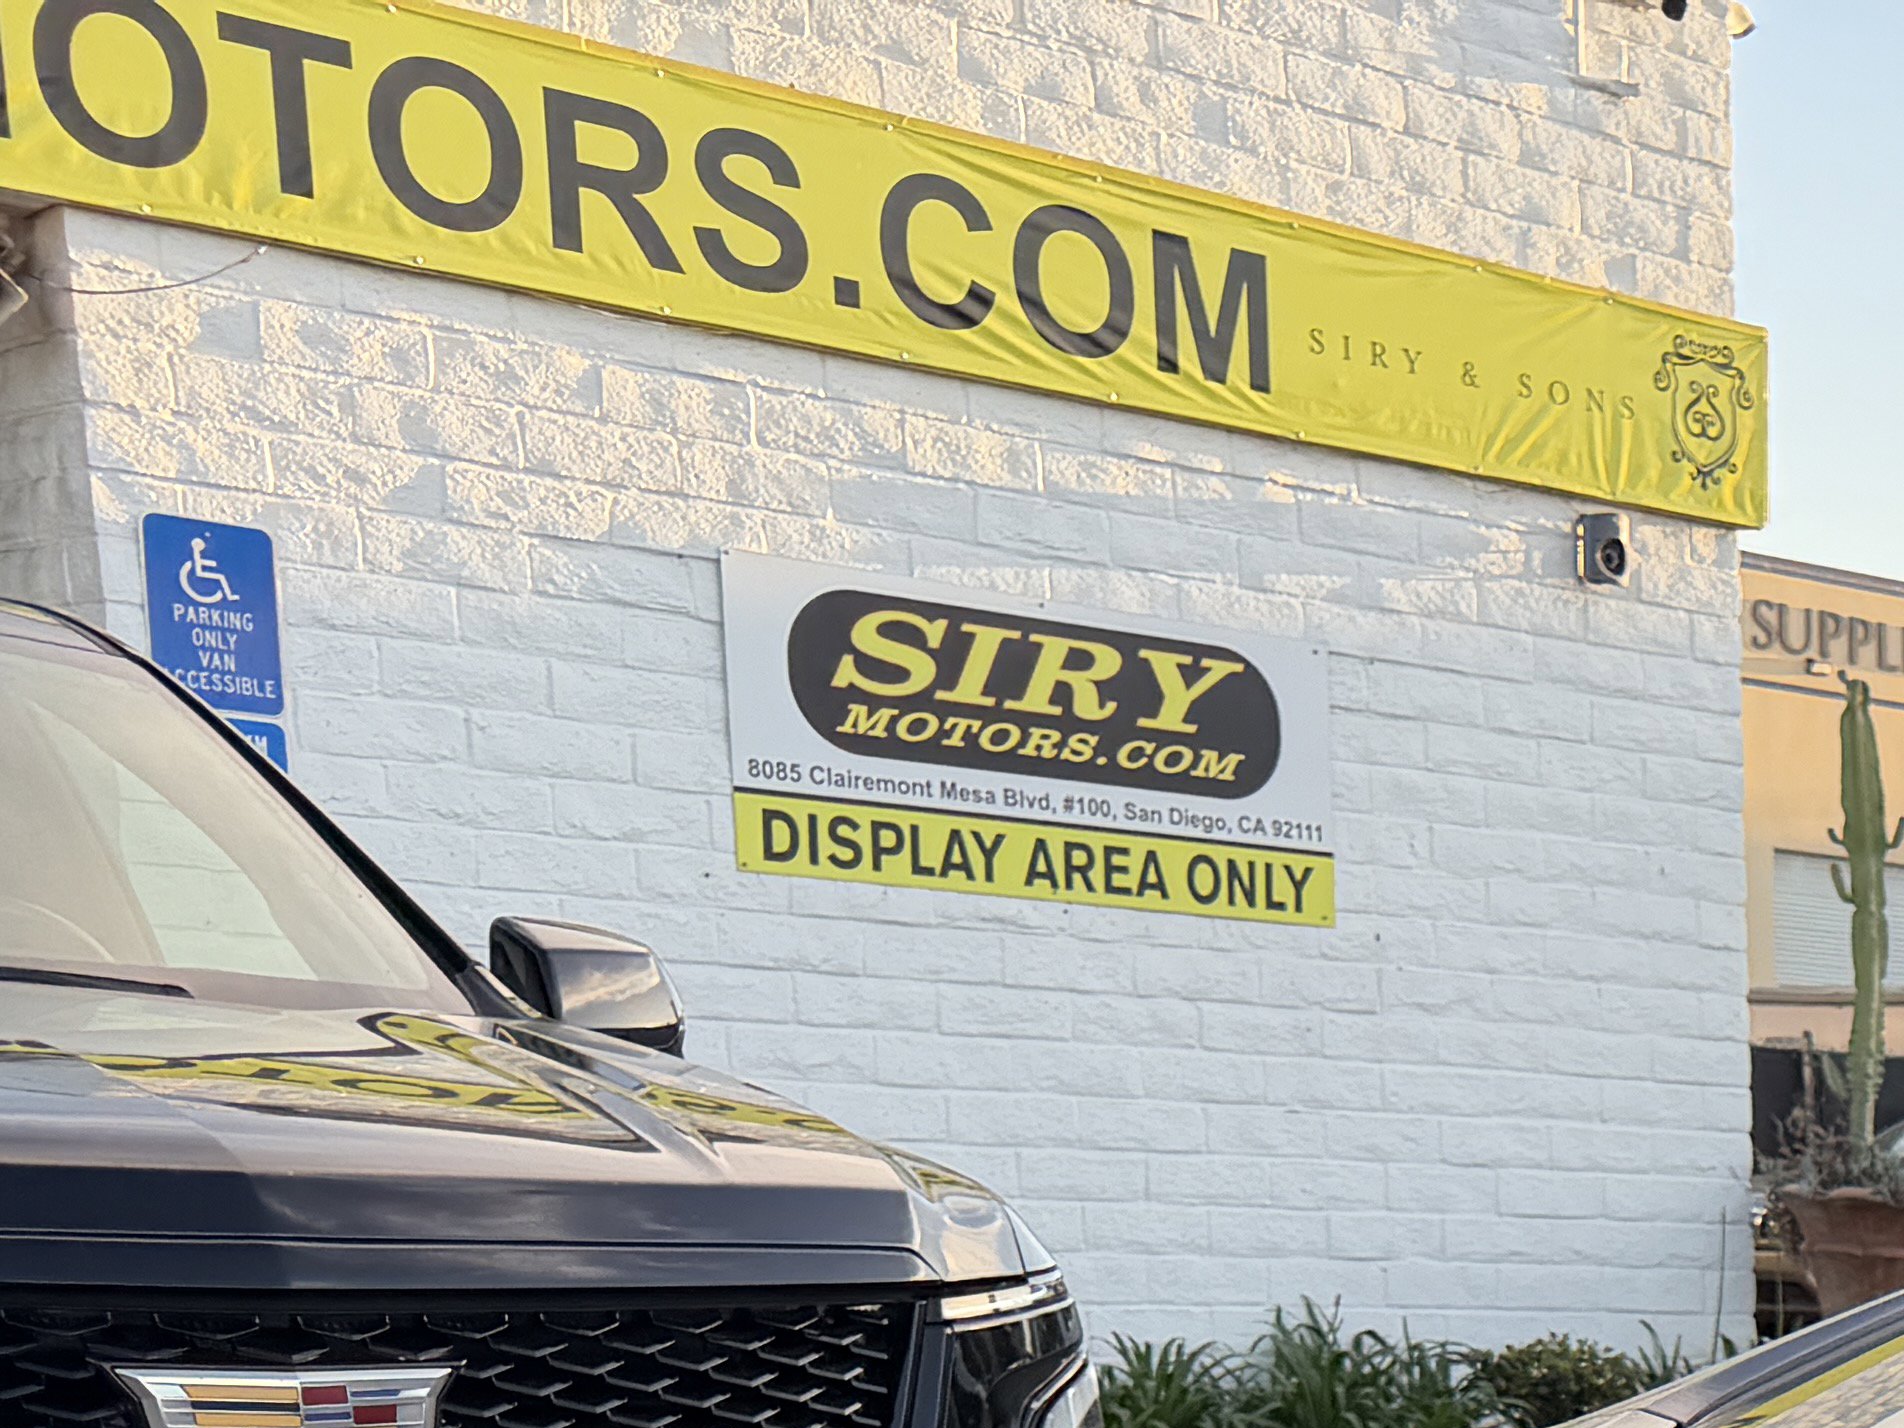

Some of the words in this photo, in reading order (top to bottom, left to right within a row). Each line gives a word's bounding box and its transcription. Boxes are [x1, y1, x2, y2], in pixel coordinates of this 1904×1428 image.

[0, 0, 1271, 395] OTORS.COM
[1308, 327, 1423, 375] SIRY
[1461, 360, 1482, 389] &
[1517, 372, 1635, 421] SONS
[173, 603, 254, 632] PARKING
[192, 626, 238, 650] ONLY
[199, 651, 236, 673] VAN
[830, 609, 1245, 734] SIRY
[836, 702, 1246, 783] MOTORS.COM
[748, 758, 802, 783] 8085
[809, 765, 934, 798] Clairemont
[940, 781, 997, 805] Mesa
[1003, 788, 1057, 815] Blvd,
[1063, 797, 1118, 822] #100,
[1123, 801, 1163, 825] San
[1168, 807, 1233, 834] Diego,
[1237, 815, 1267, 836] CA
[1272, 819, 1323, 843] 92111
[761, 807, 1007, 883] DISPLAY
[1024, 837, 1170, 900] AREA
[1186, 855, 1316, 914] ONLY
